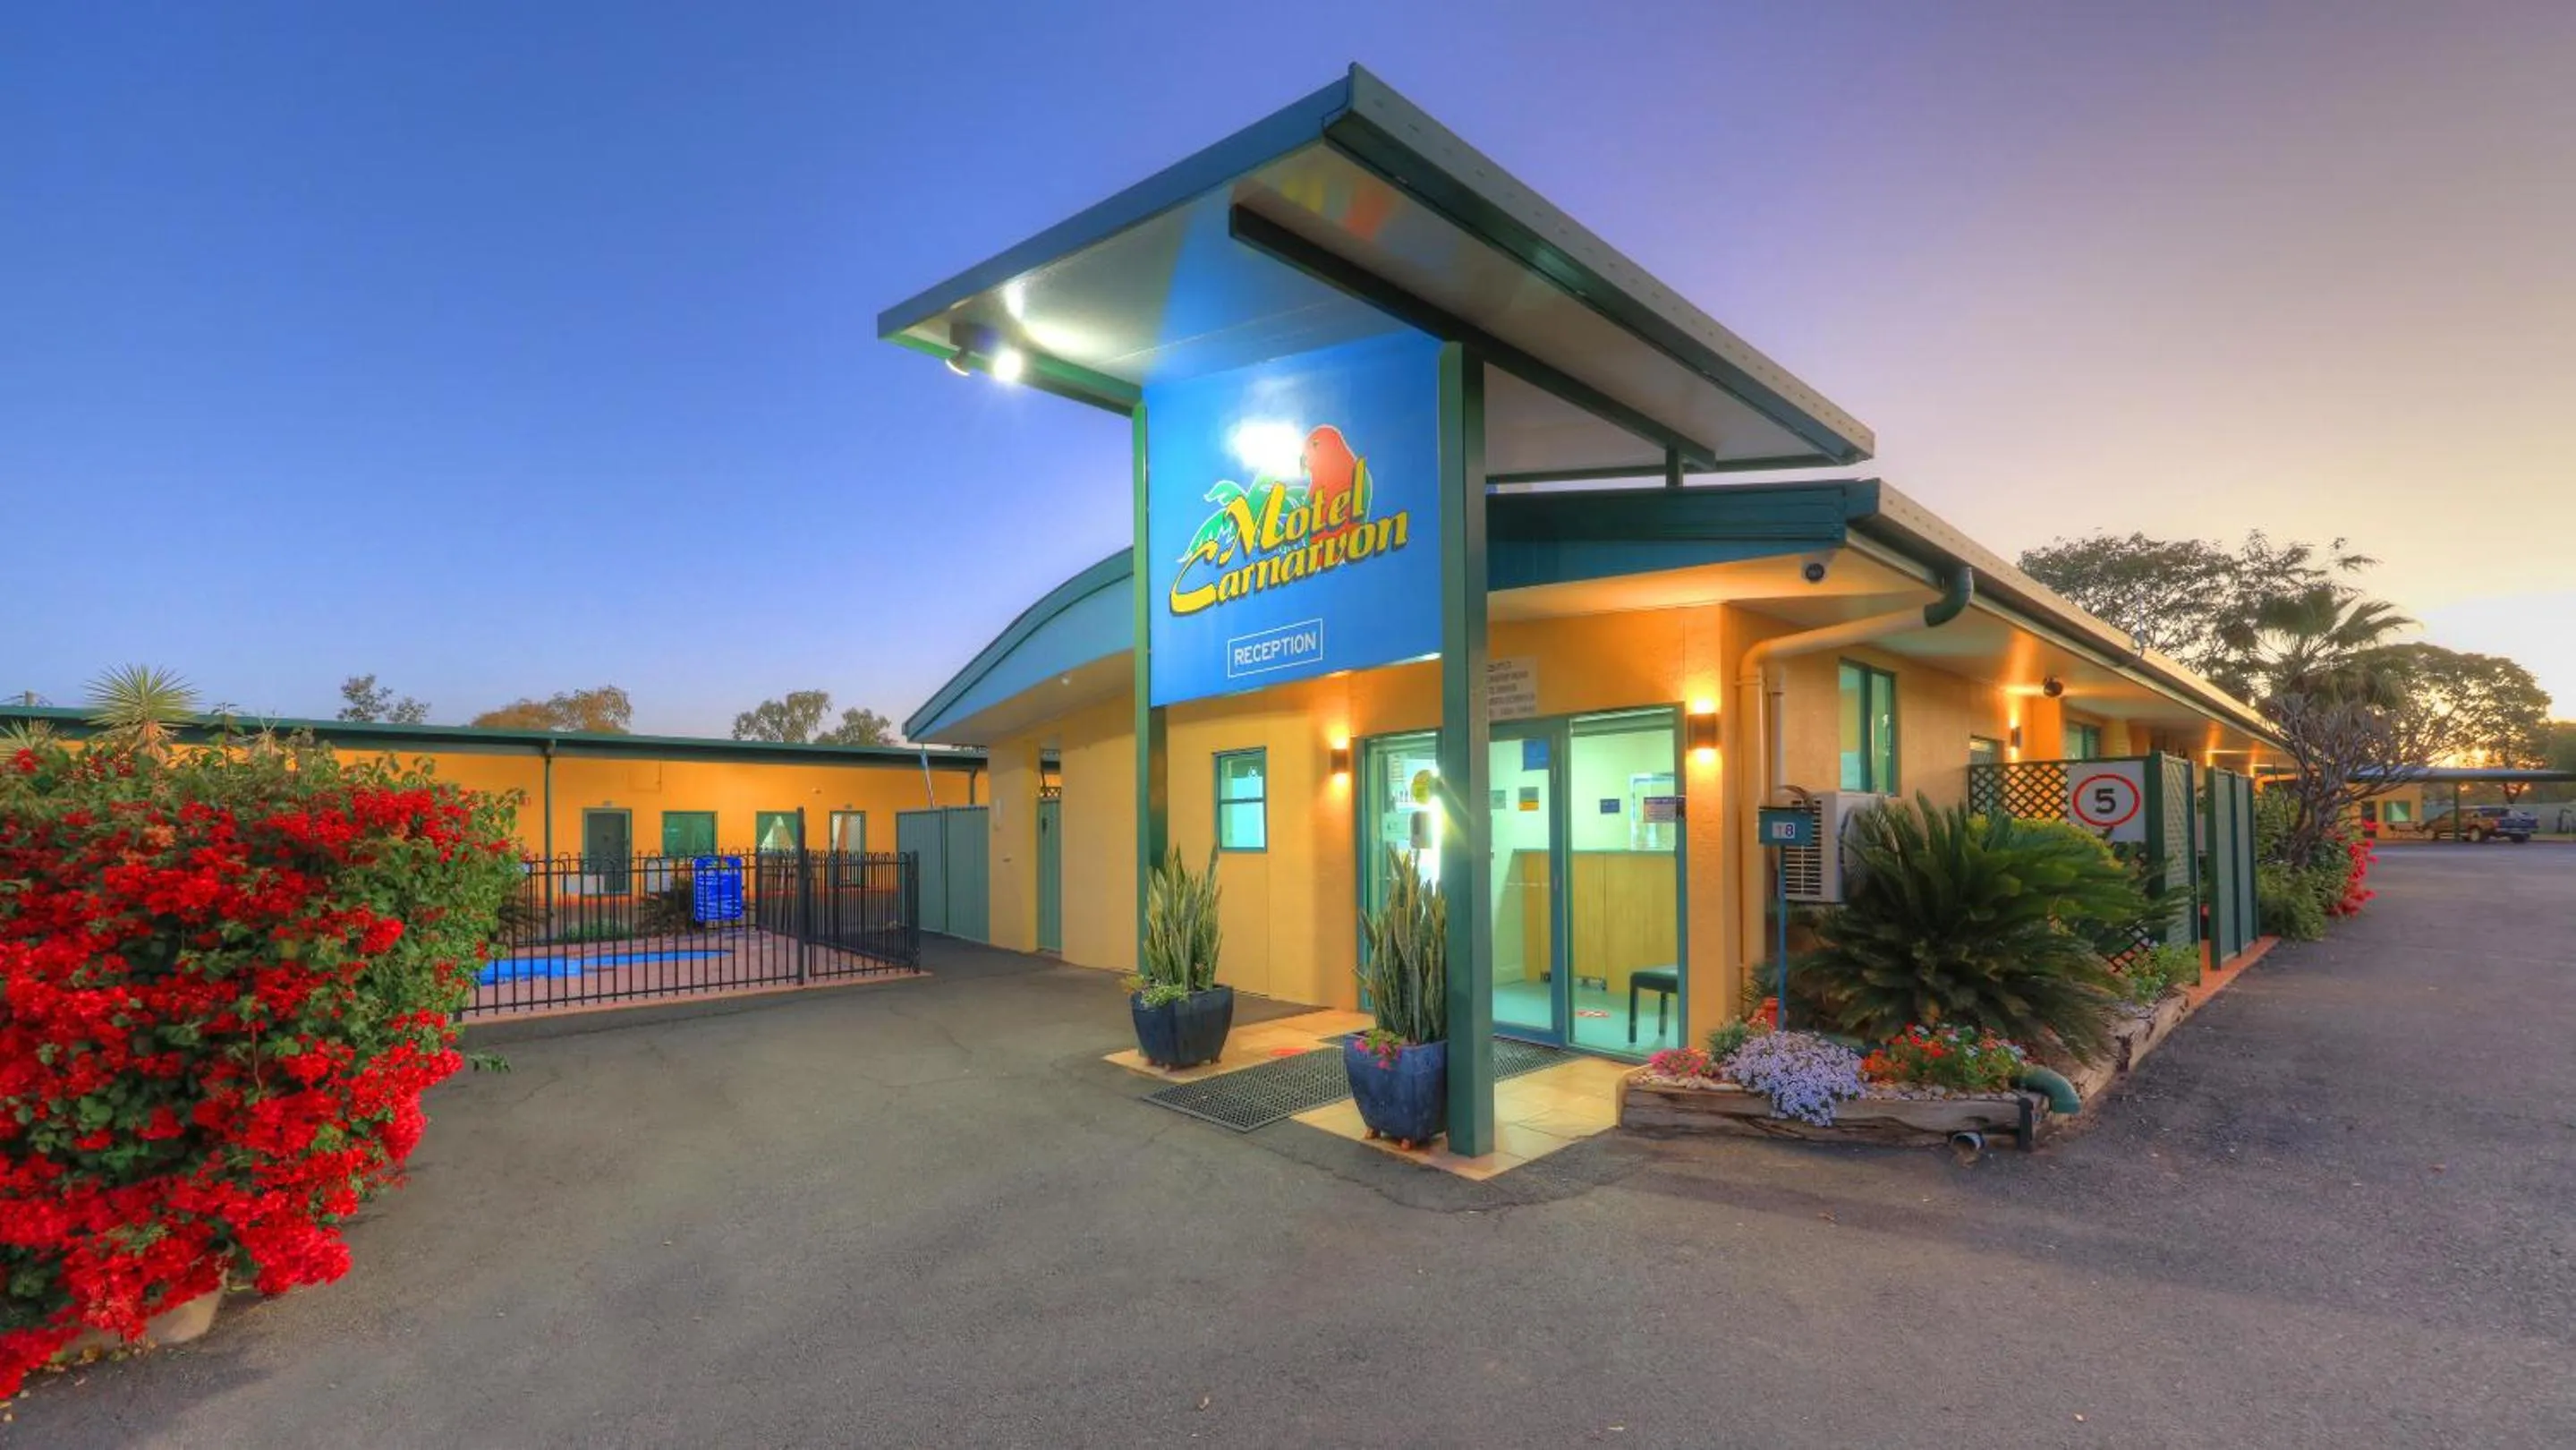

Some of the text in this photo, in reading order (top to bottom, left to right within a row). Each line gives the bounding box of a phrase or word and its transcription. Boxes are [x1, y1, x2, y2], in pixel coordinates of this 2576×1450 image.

[1218, 457, 1365, 566] Motel
[1169, 509, 1409, 616] Carnarvon
[1234, 630, 1317, 666] RECEPTION
[2095, 788, 2116, 815] 5
